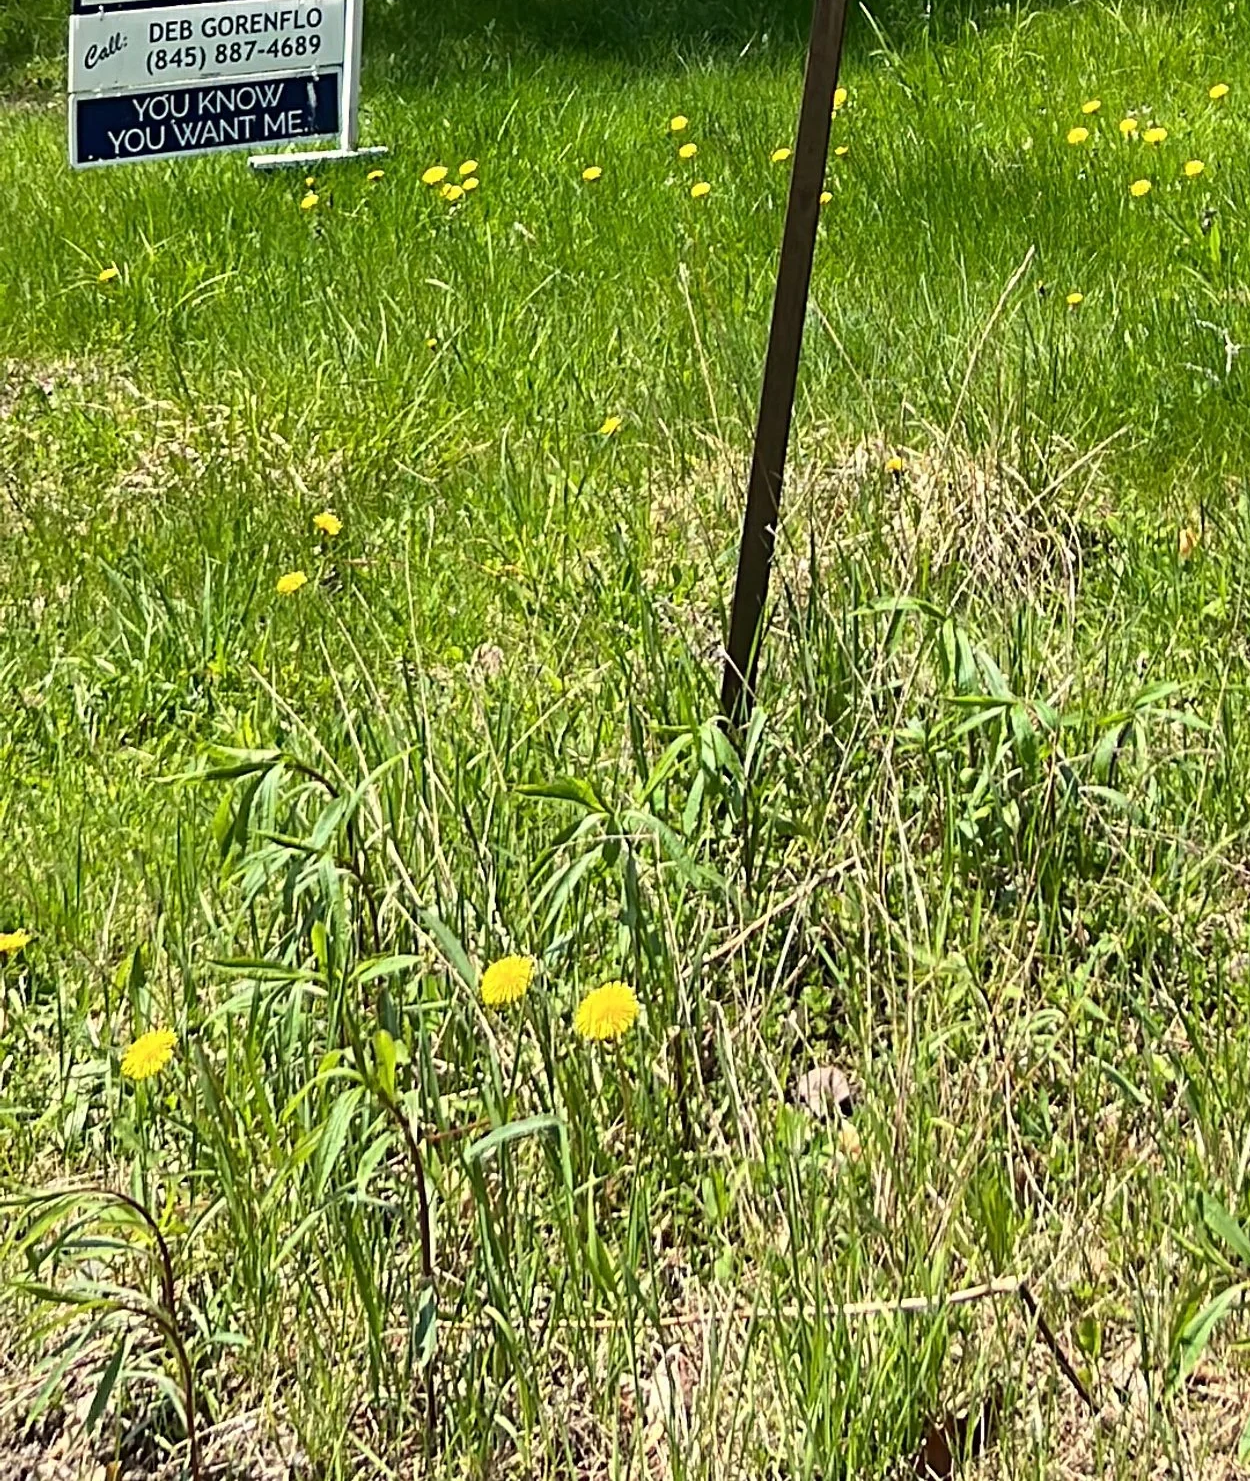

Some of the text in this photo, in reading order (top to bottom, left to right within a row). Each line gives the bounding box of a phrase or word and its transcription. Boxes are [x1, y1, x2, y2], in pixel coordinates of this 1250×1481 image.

[149, 7, 323, 43] DEB GORENFLO
[84, 32, 128, 70] Call:
[146, 34, 321, 75] (845) 887-4689
[132, 83, 285, 122] YOU KNOW
[107, 109, 309, 154] YOU WANT ME.
